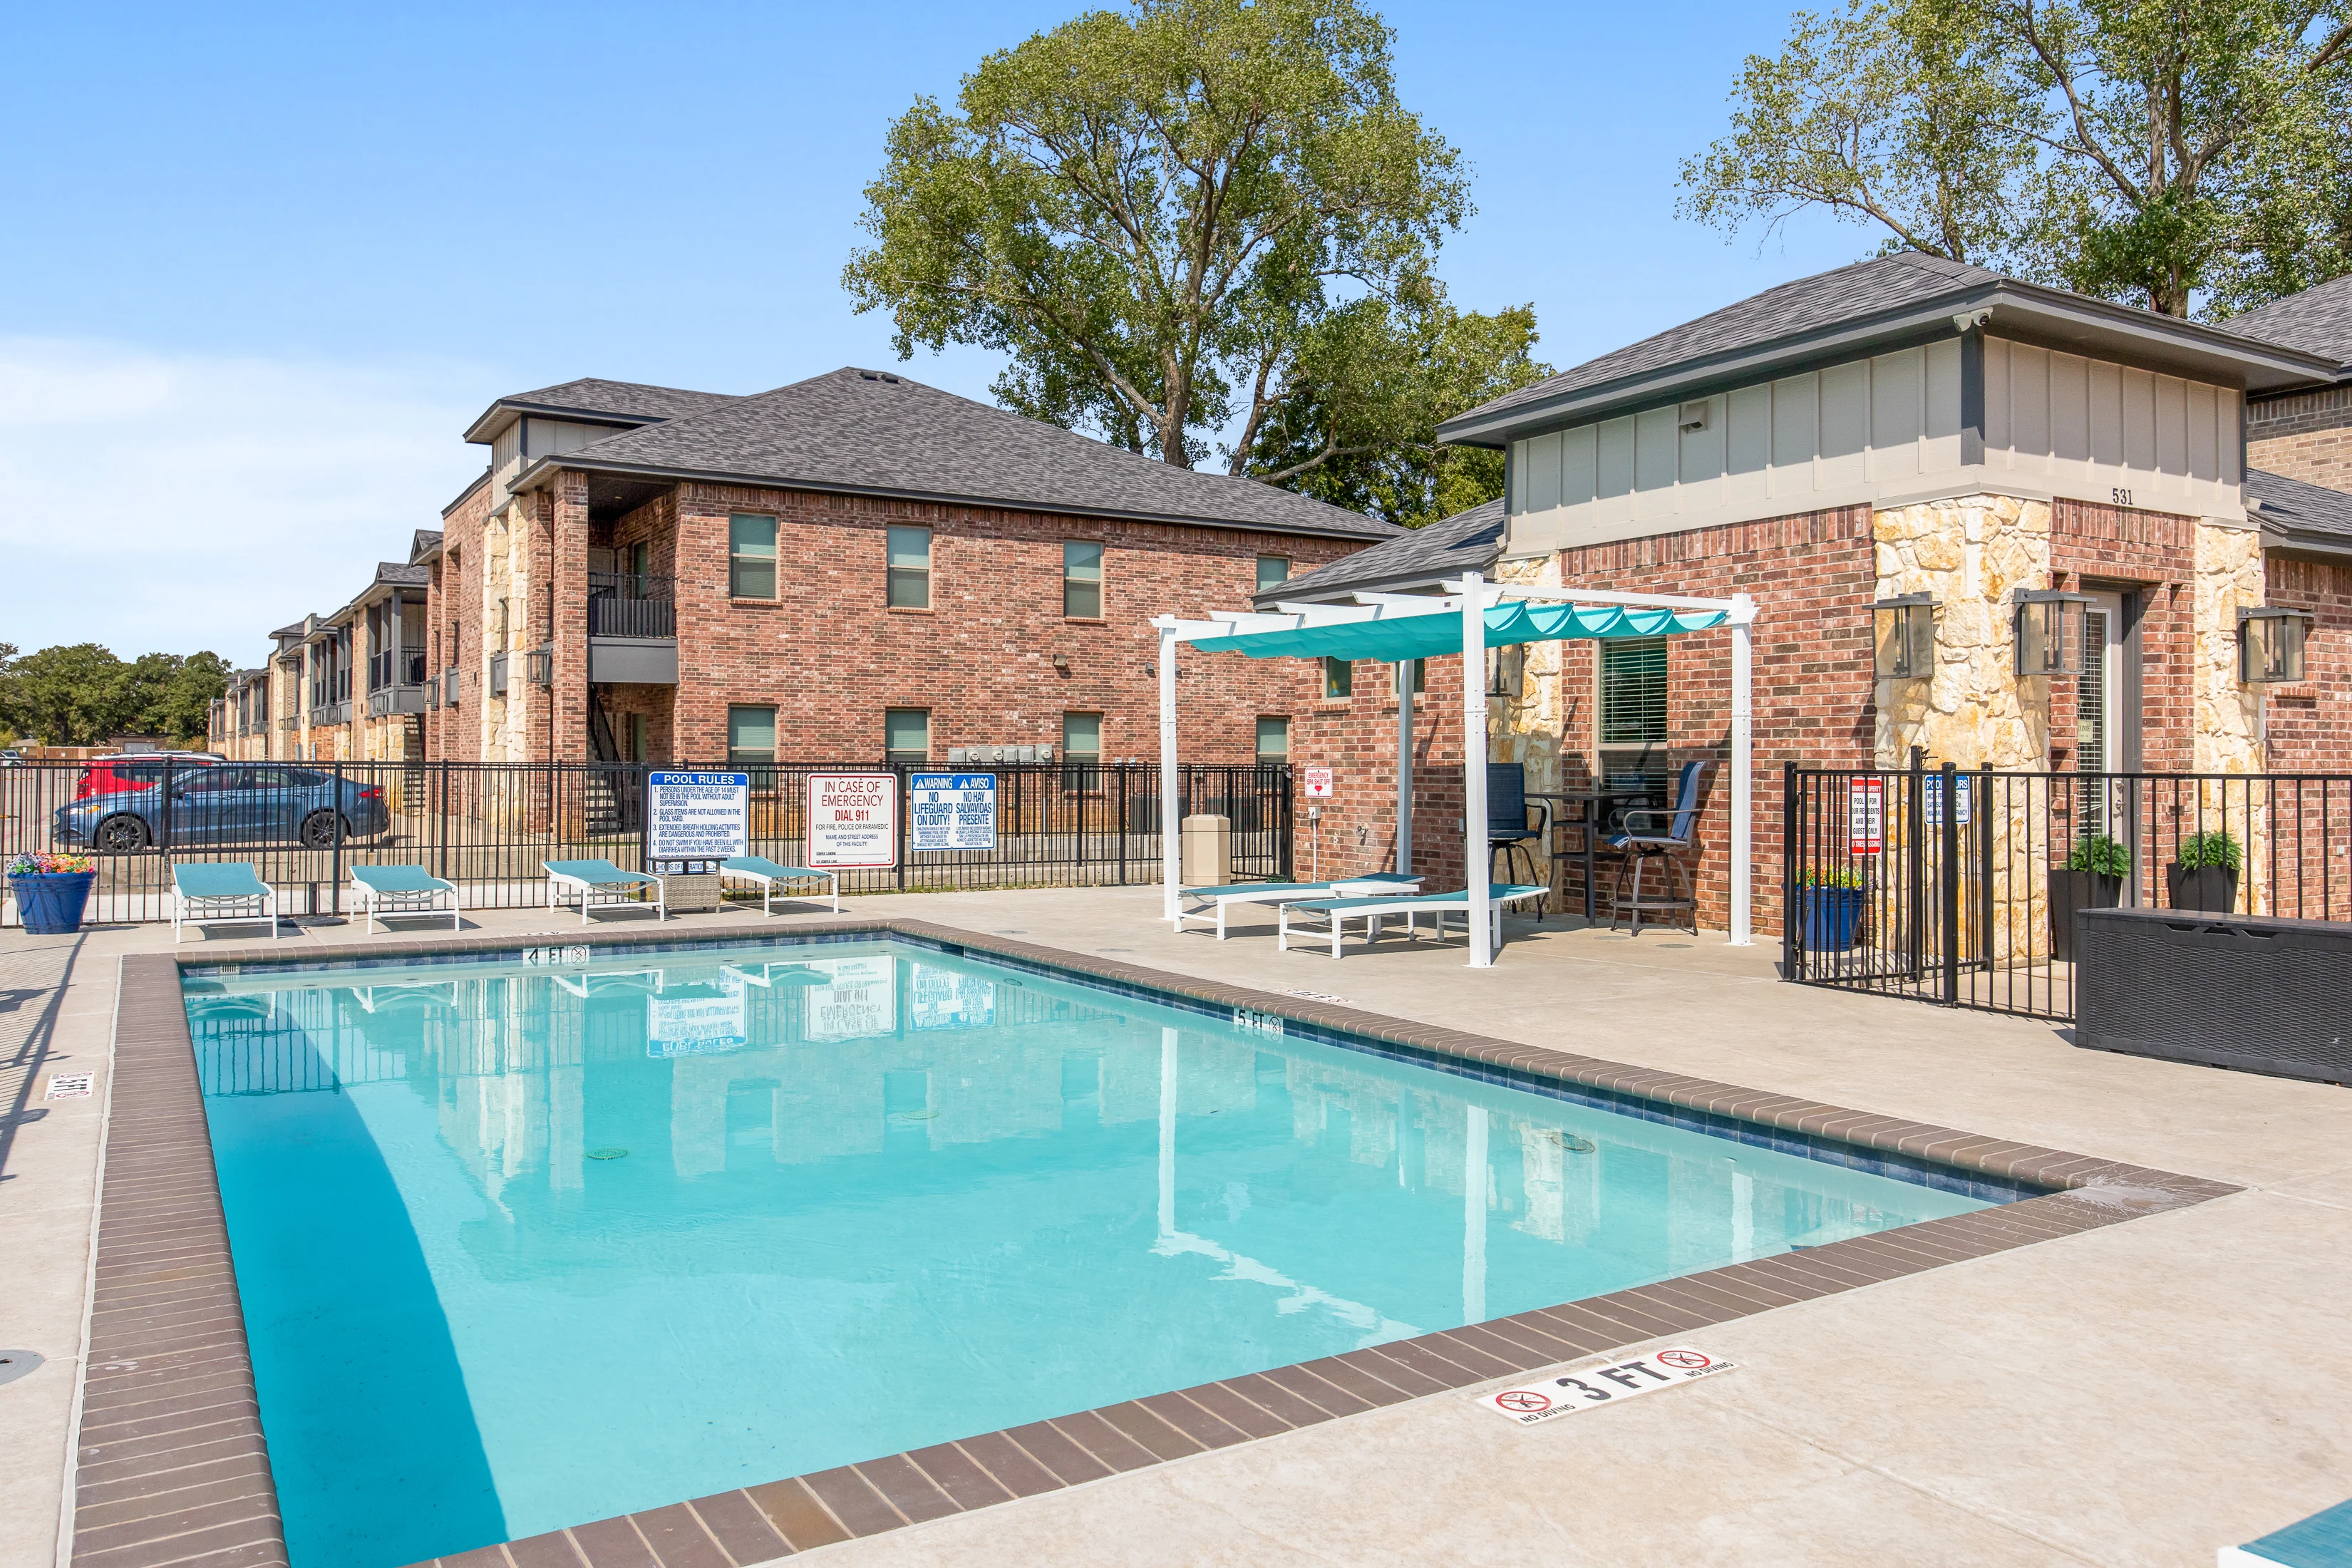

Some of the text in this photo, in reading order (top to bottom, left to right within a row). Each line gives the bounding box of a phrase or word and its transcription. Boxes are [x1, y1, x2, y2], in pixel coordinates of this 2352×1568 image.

[2113, 488, 2133, 505] 531
[664, 775, 735, 784] POOL RULES
[924, 778, 952, 789] WARNING
[970, 778, 989, 789] AVISO
[825, 781, 880, 793] IN CASE OF
[822, 795, 883, 806] EMERGENCY
[929, 792, 939, 802] NO
[964, 792, 985, 802] NO HAY
[914, 803, 953, 814] LIFEGUARD
[956, 803, 991, 813] SALVAVIDAS
[835, 810, 869, 821] DIAL 911
[917, 815, 949, 825] ON DUTY!
[959, 814, 989, 825] PRESENTE
[528, 947, 564, 959] 4 FT
[1239, 1009, 1264, 1028] 5 FT
[1699, 1362, 1733, 1373] DIVING
[1556, 1361, 1671, 1401] 3 FT
[1520, 1404, 1576, 1423] NO DIVING
